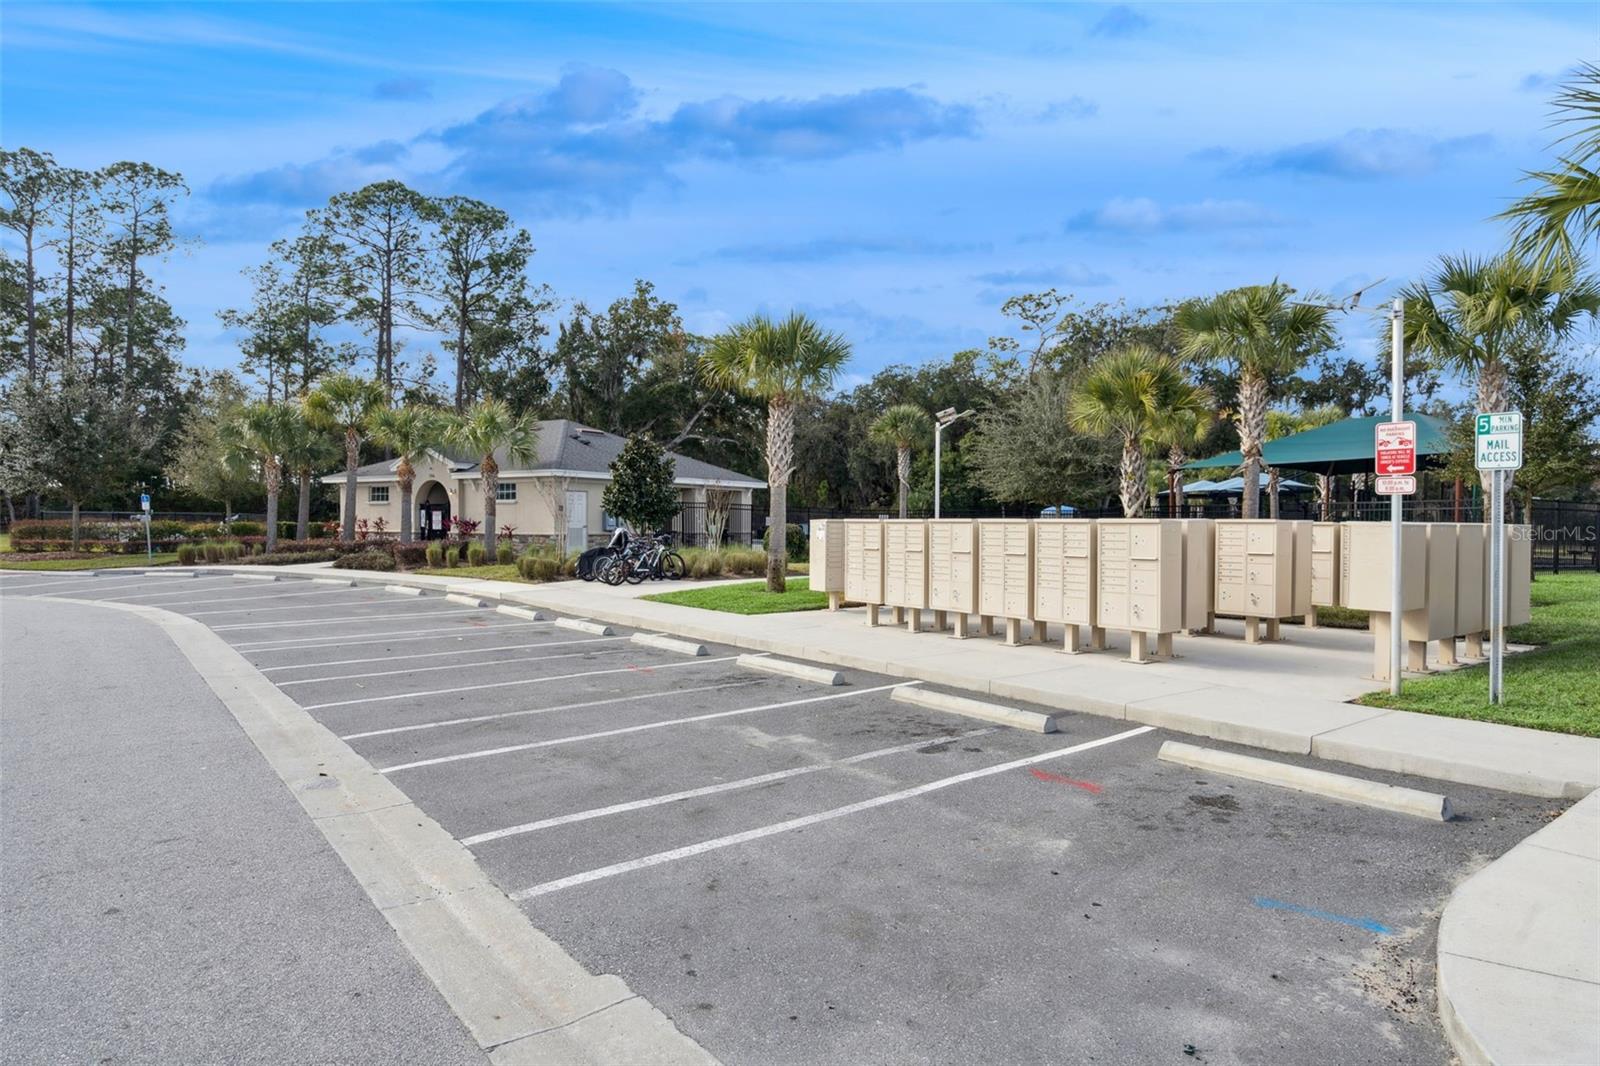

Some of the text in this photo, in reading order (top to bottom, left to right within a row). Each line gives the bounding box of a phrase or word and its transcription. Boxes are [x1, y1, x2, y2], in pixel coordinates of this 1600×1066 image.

[1479, 417, 1489, 432] 5
[1499, 415, 1513, 423] MIN
[1491, 424, 1519, 433] PARKING
[1487, 439, 1510, 450] MAIL
[1480, 451, 1517, 462] ACCESS
